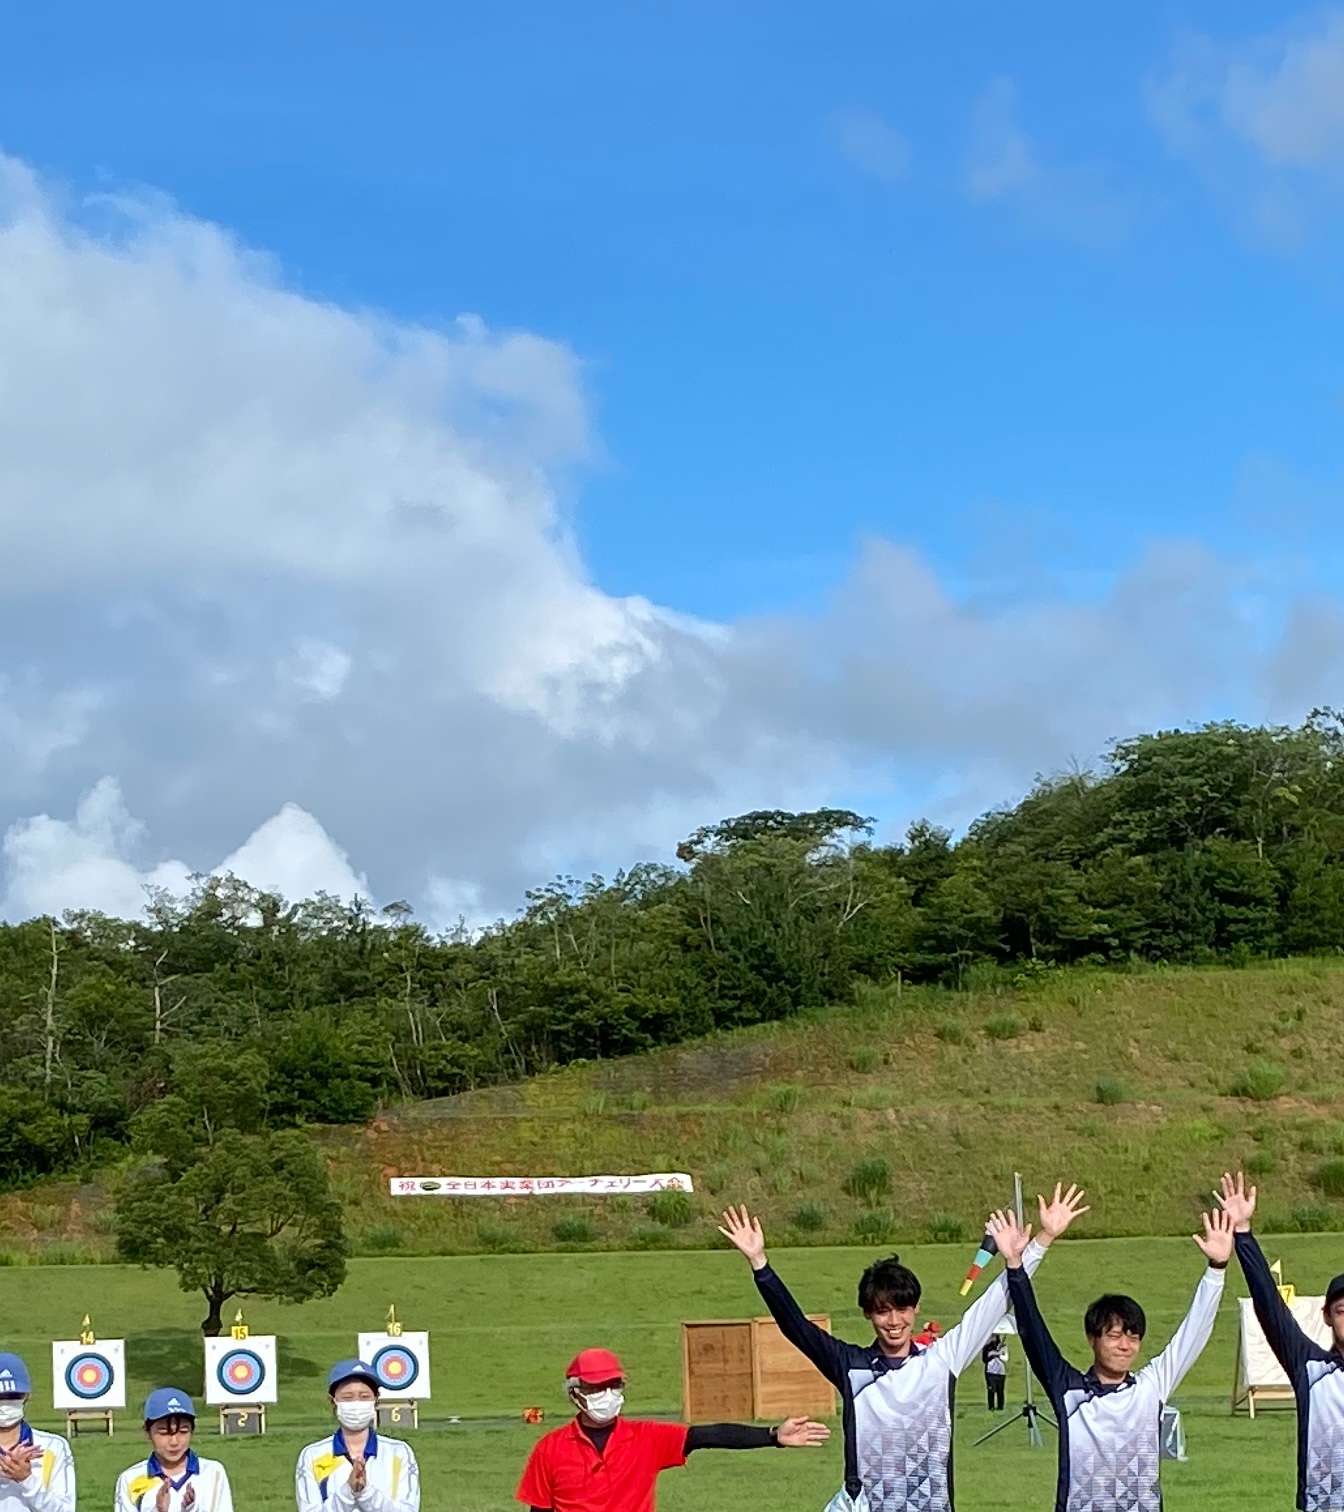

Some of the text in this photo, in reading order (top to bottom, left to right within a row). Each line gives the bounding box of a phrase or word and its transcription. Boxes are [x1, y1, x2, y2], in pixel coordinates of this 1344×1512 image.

[234, 1327, 246, 1341] 15
[387, 1322, 401, 1336] 16
[80, 1330, 94, 1345] 14
[237, 1411, 248, 1427] 2
[391, 1406, 401, 1422] 6
